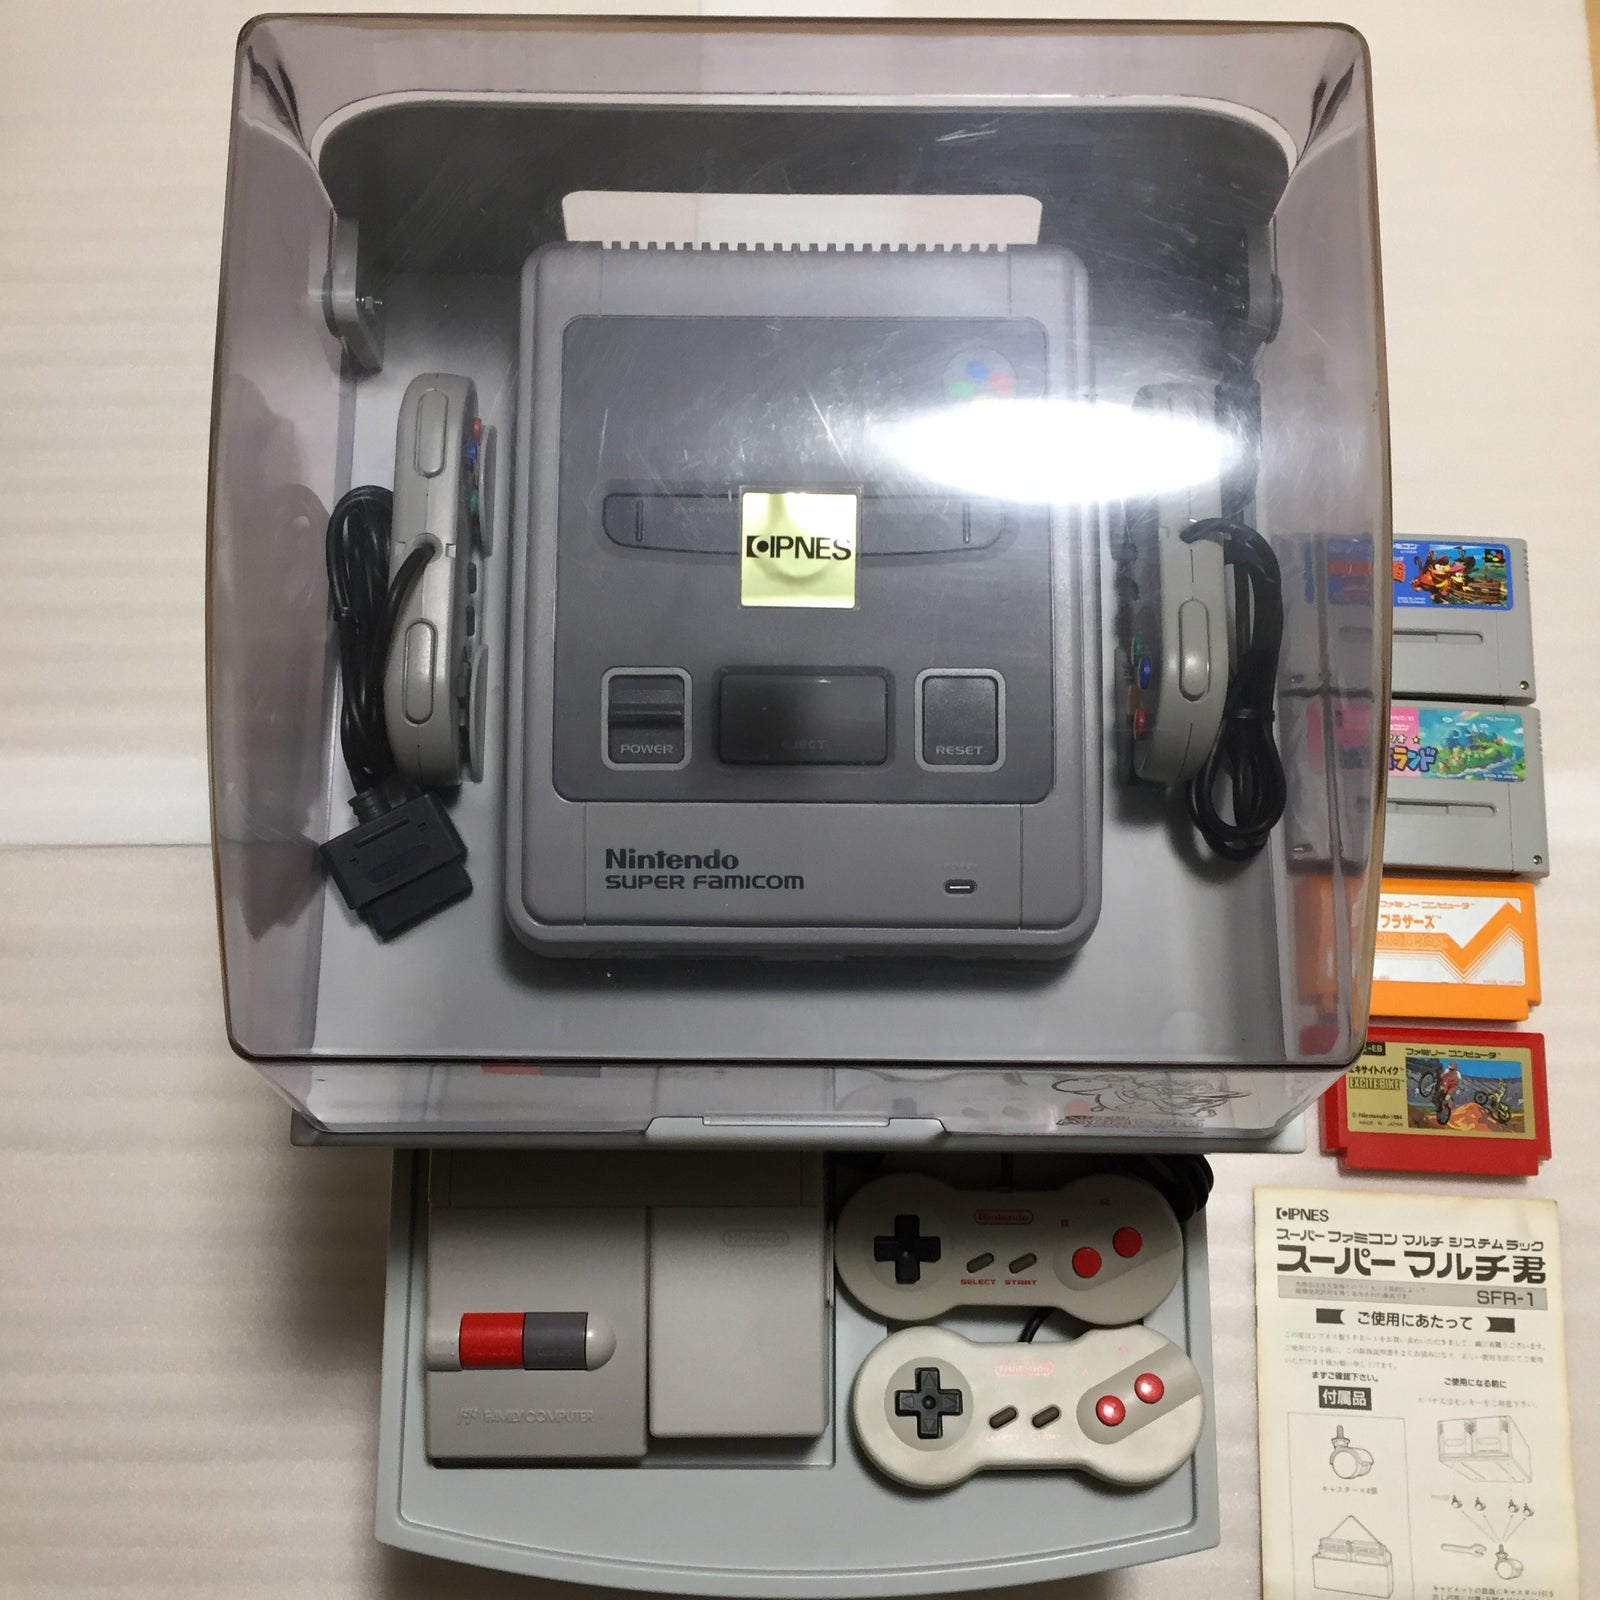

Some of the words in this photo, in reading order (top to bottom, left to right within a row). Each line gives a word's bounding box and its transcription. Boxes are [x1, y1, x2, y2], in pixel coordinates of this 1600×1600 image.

[620, 744, 674, 755] POWER
[935, 745, 984, 756] RESET
[605, 848, 740, 870] Nintendo
[604, 874, 686, 890] SUPER
[1405, 1047, 1446, 1057] ファミリー
[1448, 1049, 1498, 1059] コンピュータ
[1276, 1228, 1325, 1242] スーパー
[1327, 1230, 1398, 1246] ファミコン
[1402, 1234, 1444, 1248] マルチ
[1476, 1290, 1535, 1307] SFR-1
[1357, 1311, 1473, 1331] ご使用にあたって
[1312, 1371, 1379, 1383] まずご確認下さい。
[1444, 1377, 1508, 1389] ご使用になる前に
[1322, 1388, 1368, 1407] 付属品
